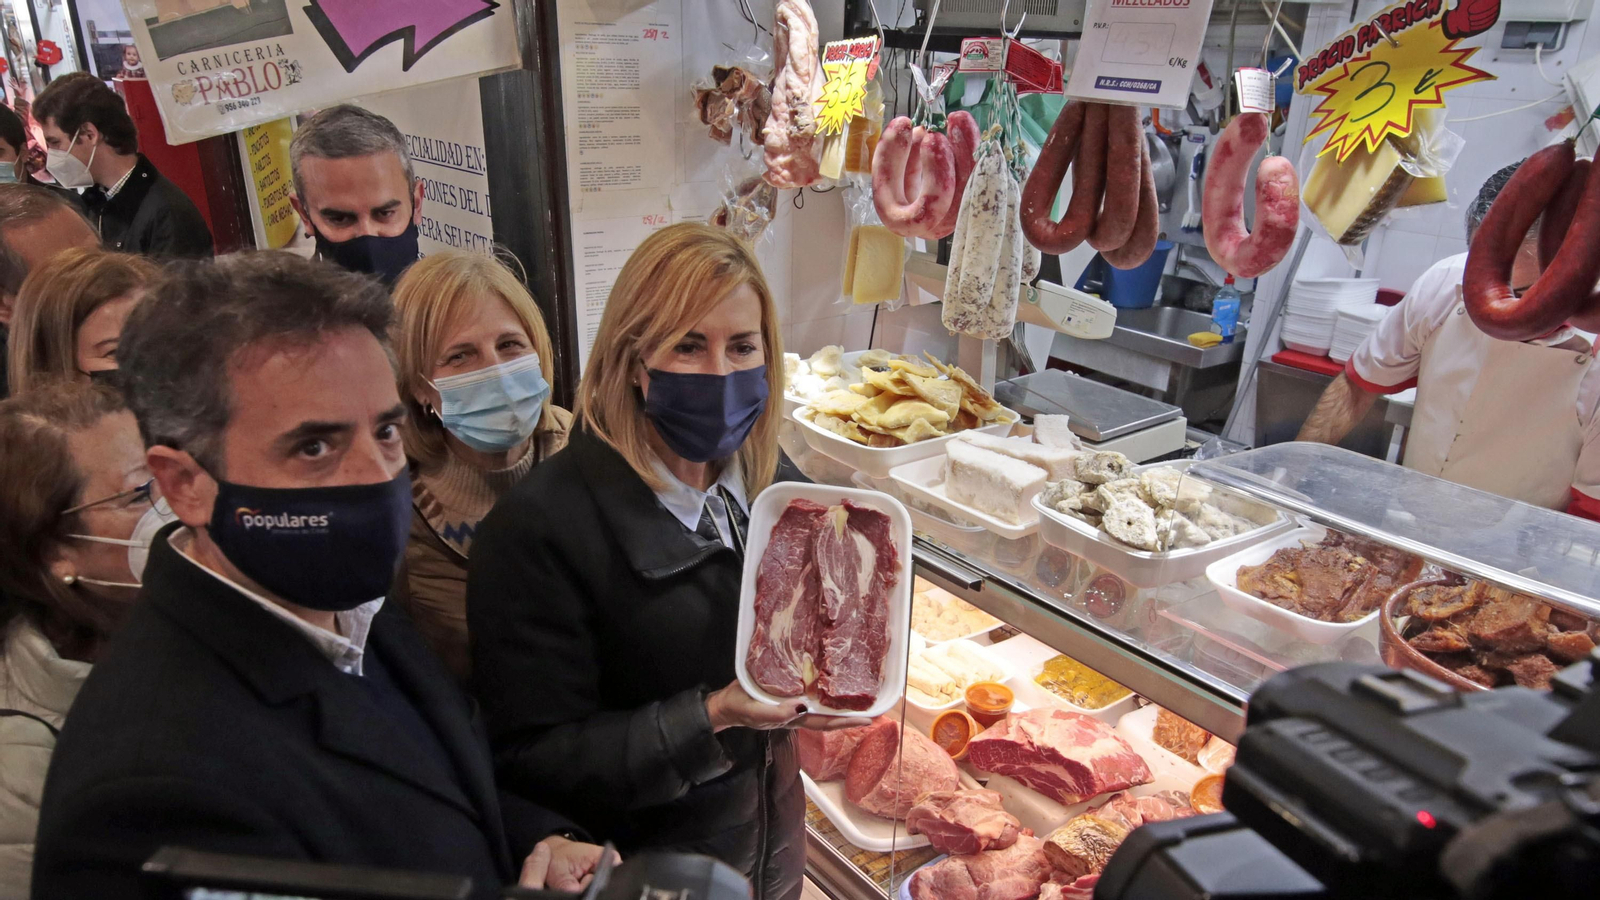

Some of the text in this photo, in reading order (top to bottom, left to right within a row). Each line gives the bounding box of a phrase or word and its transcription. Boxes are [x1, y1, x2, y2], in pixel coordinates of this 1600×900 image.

[177, 43, 285, 75] CARNICERIA
[1298, 34, 1355, 90] PRECIO
[195, 61, 282, 105] PABLO
[1350, 60, 1396, 123] 3
[465, 145, 486, 172] EN:
[459, 187, 484, 216] DEL
[242, 511, 329, 531] populares
